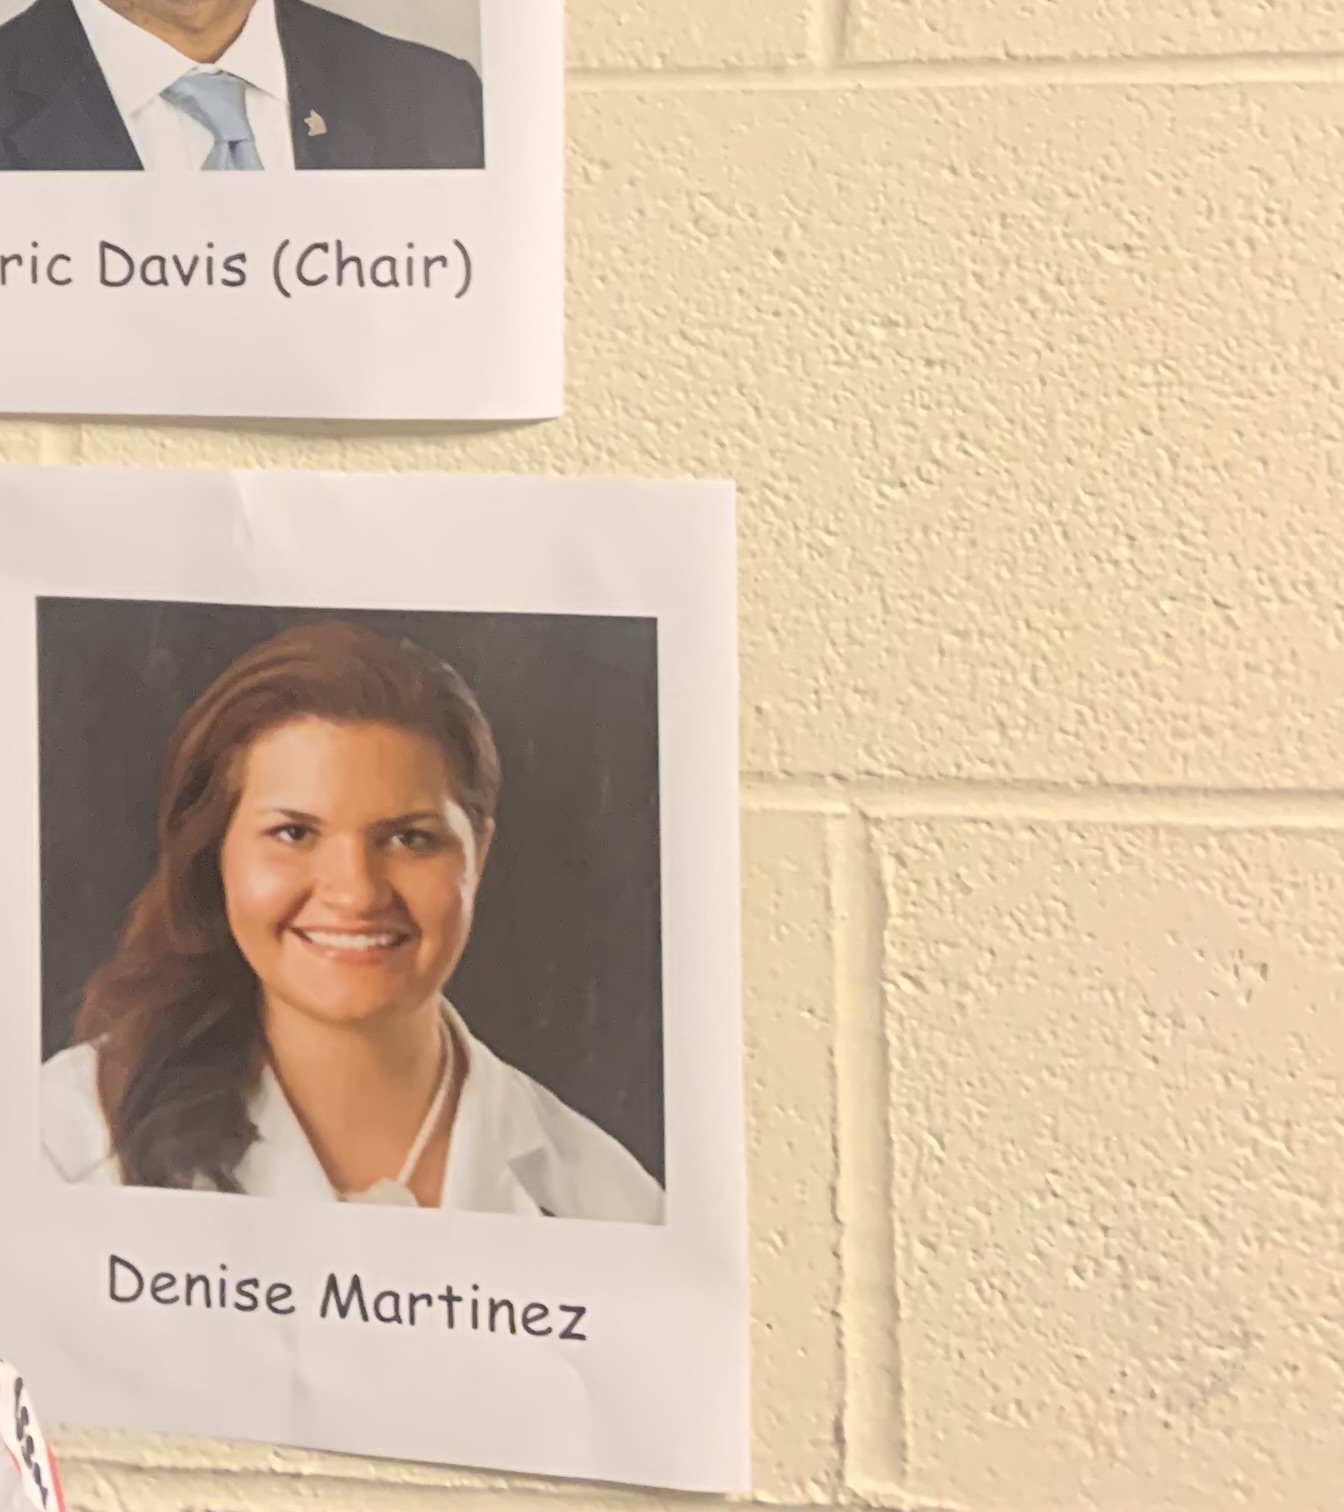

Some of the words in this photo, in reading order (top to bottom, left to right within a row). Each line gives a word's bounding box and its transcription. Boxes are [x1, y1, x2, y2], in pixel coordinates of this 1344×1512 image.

[99, 240, 248, 288] Davis
[272, 238, 473, 300] (Chair)
[108, 1253, 296, 1316] Denise
[319, 1271, 589, 1342] Martinez
